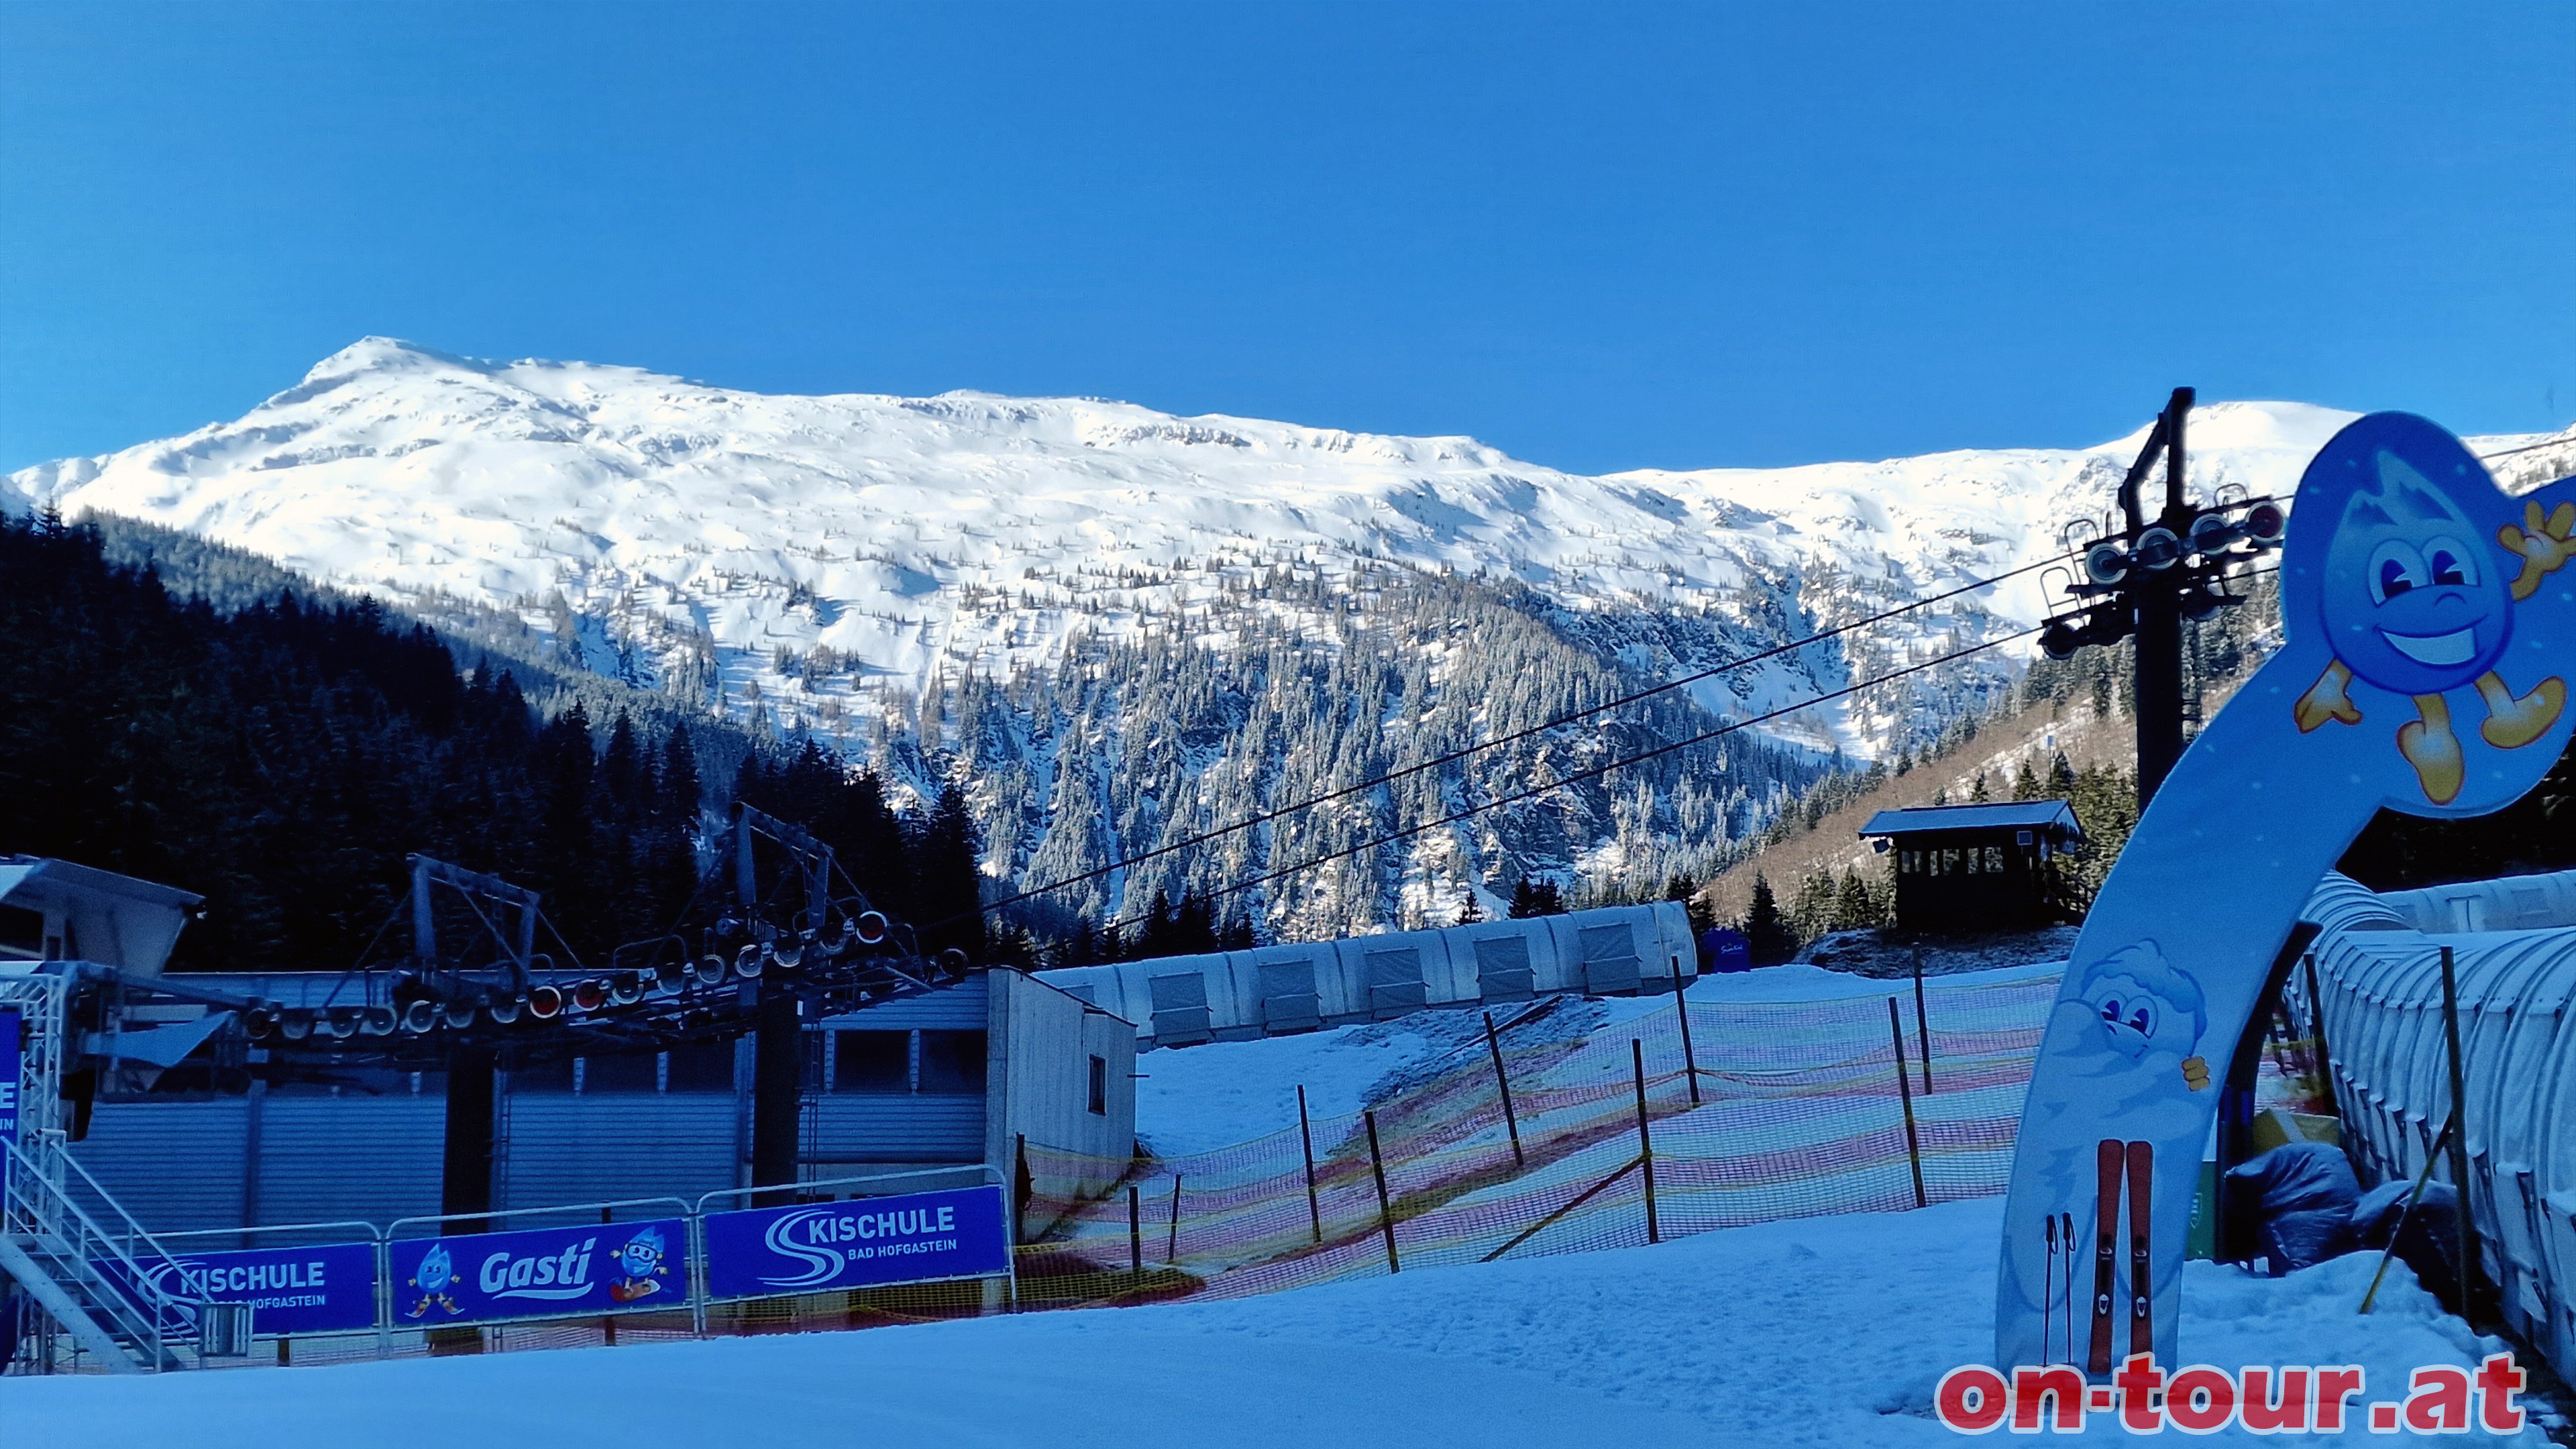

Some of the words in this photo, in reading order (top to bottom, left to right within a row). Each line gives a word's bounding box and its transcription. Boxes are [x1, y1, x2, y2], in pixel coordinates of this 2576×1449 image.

[480, 1237, 597, 1293] Gasti
[848, 1246, 874, 1260] BAD
[877, 1238, 957, 1258] HOFGASTEIN
